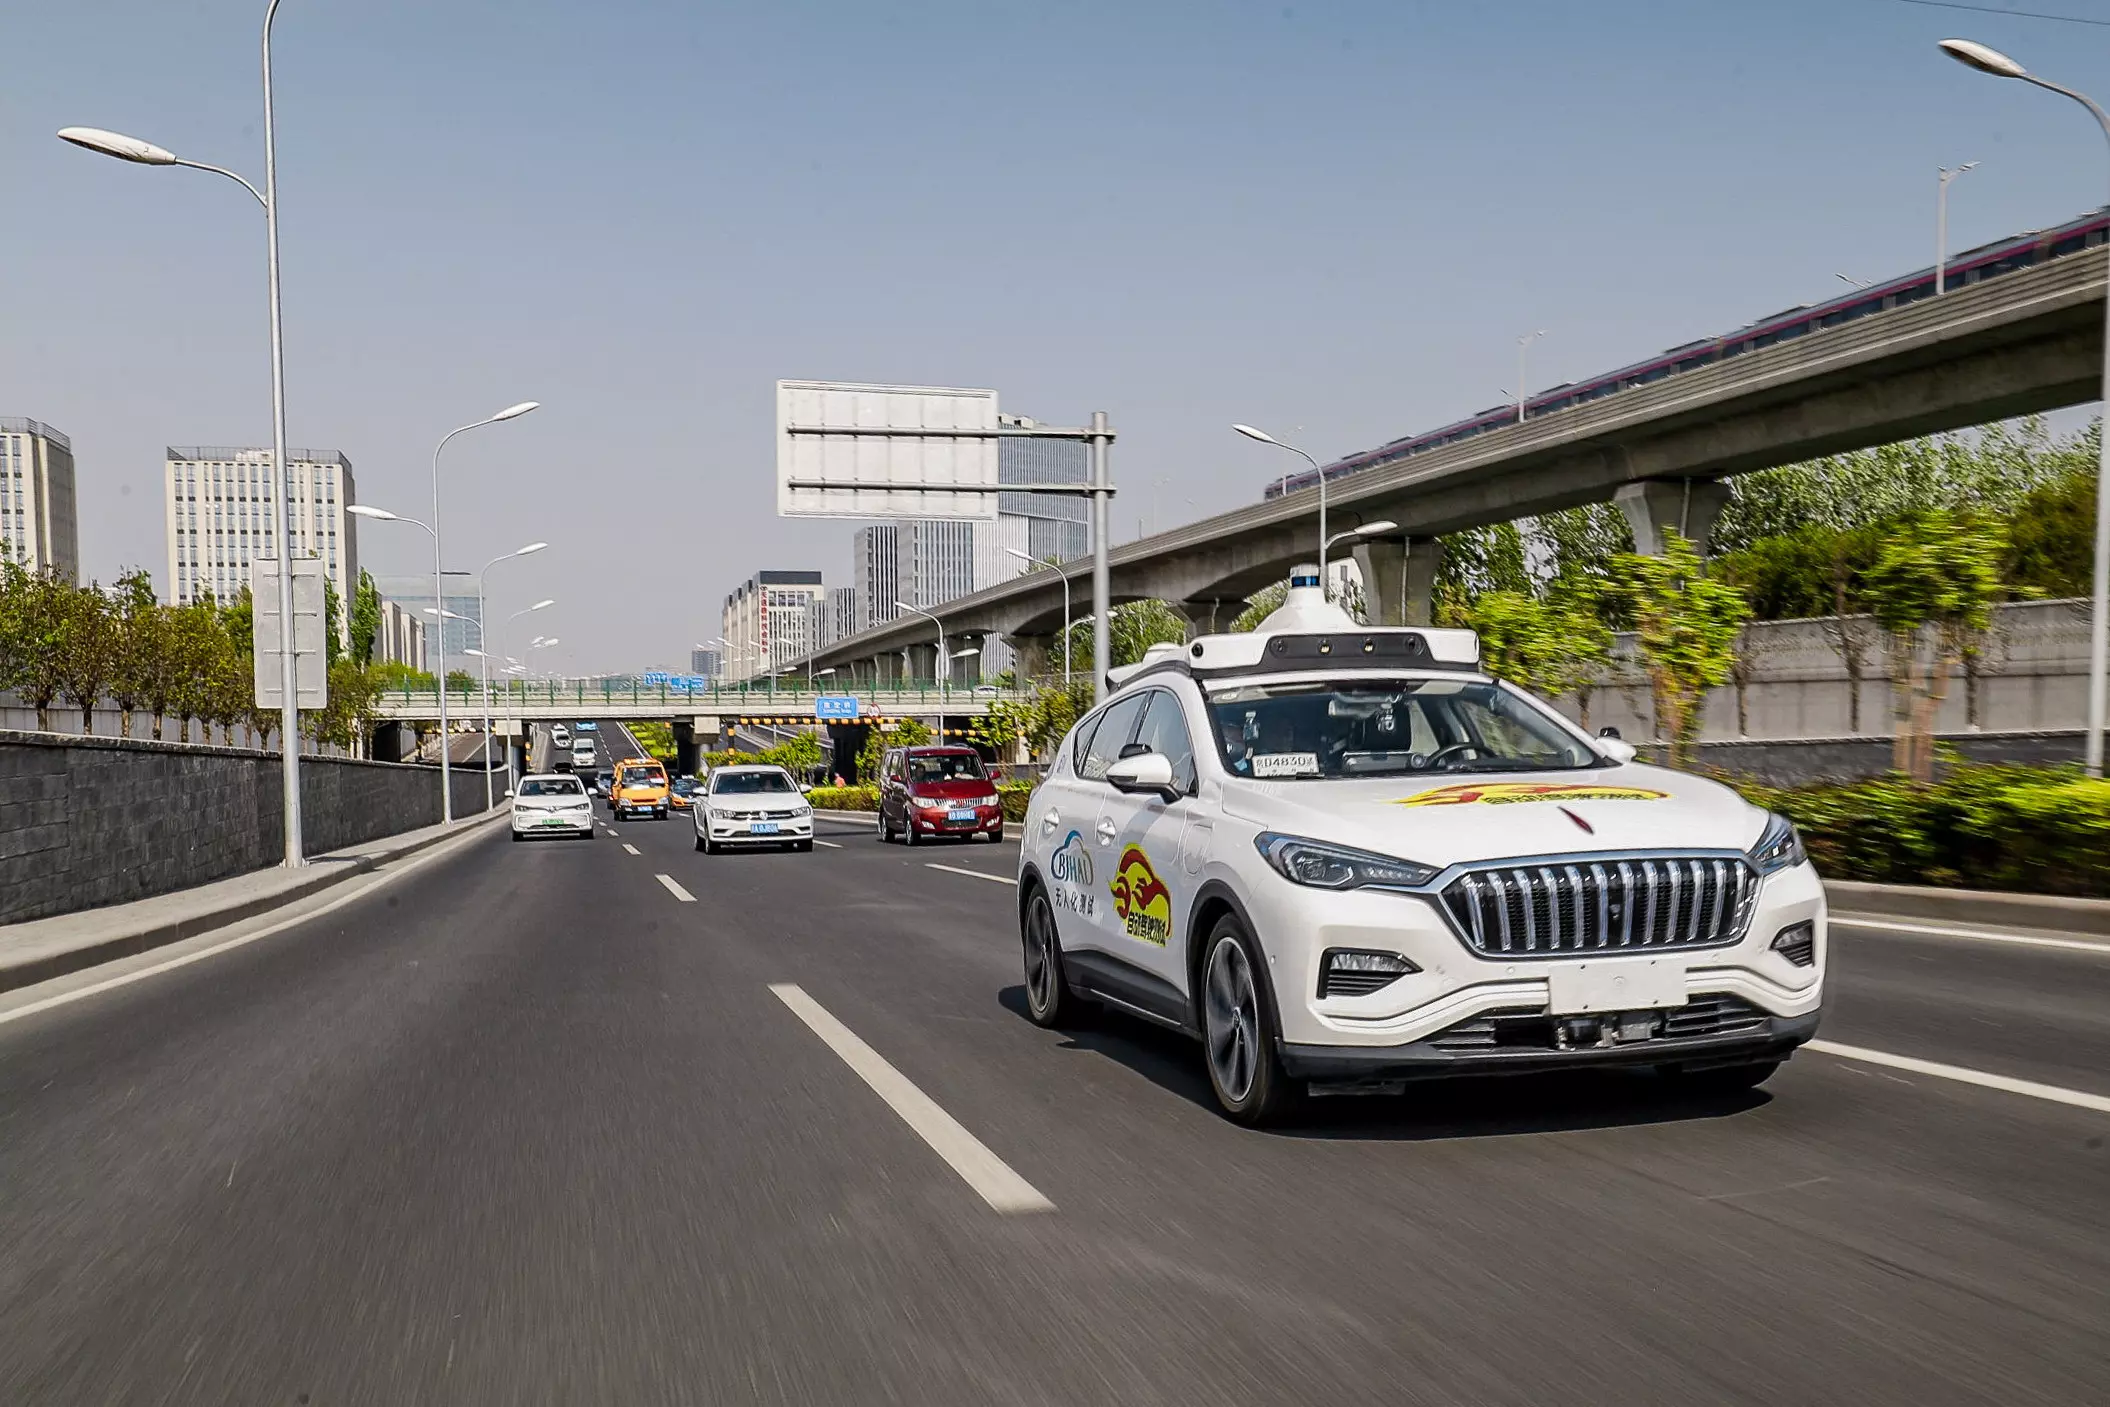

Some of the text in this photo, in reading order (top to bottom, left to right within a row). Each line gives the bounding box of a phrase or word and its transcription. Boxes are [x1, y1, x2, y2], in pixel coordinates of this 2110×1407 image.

[1127, 910, 1167, 947] 自动驾驶测试
